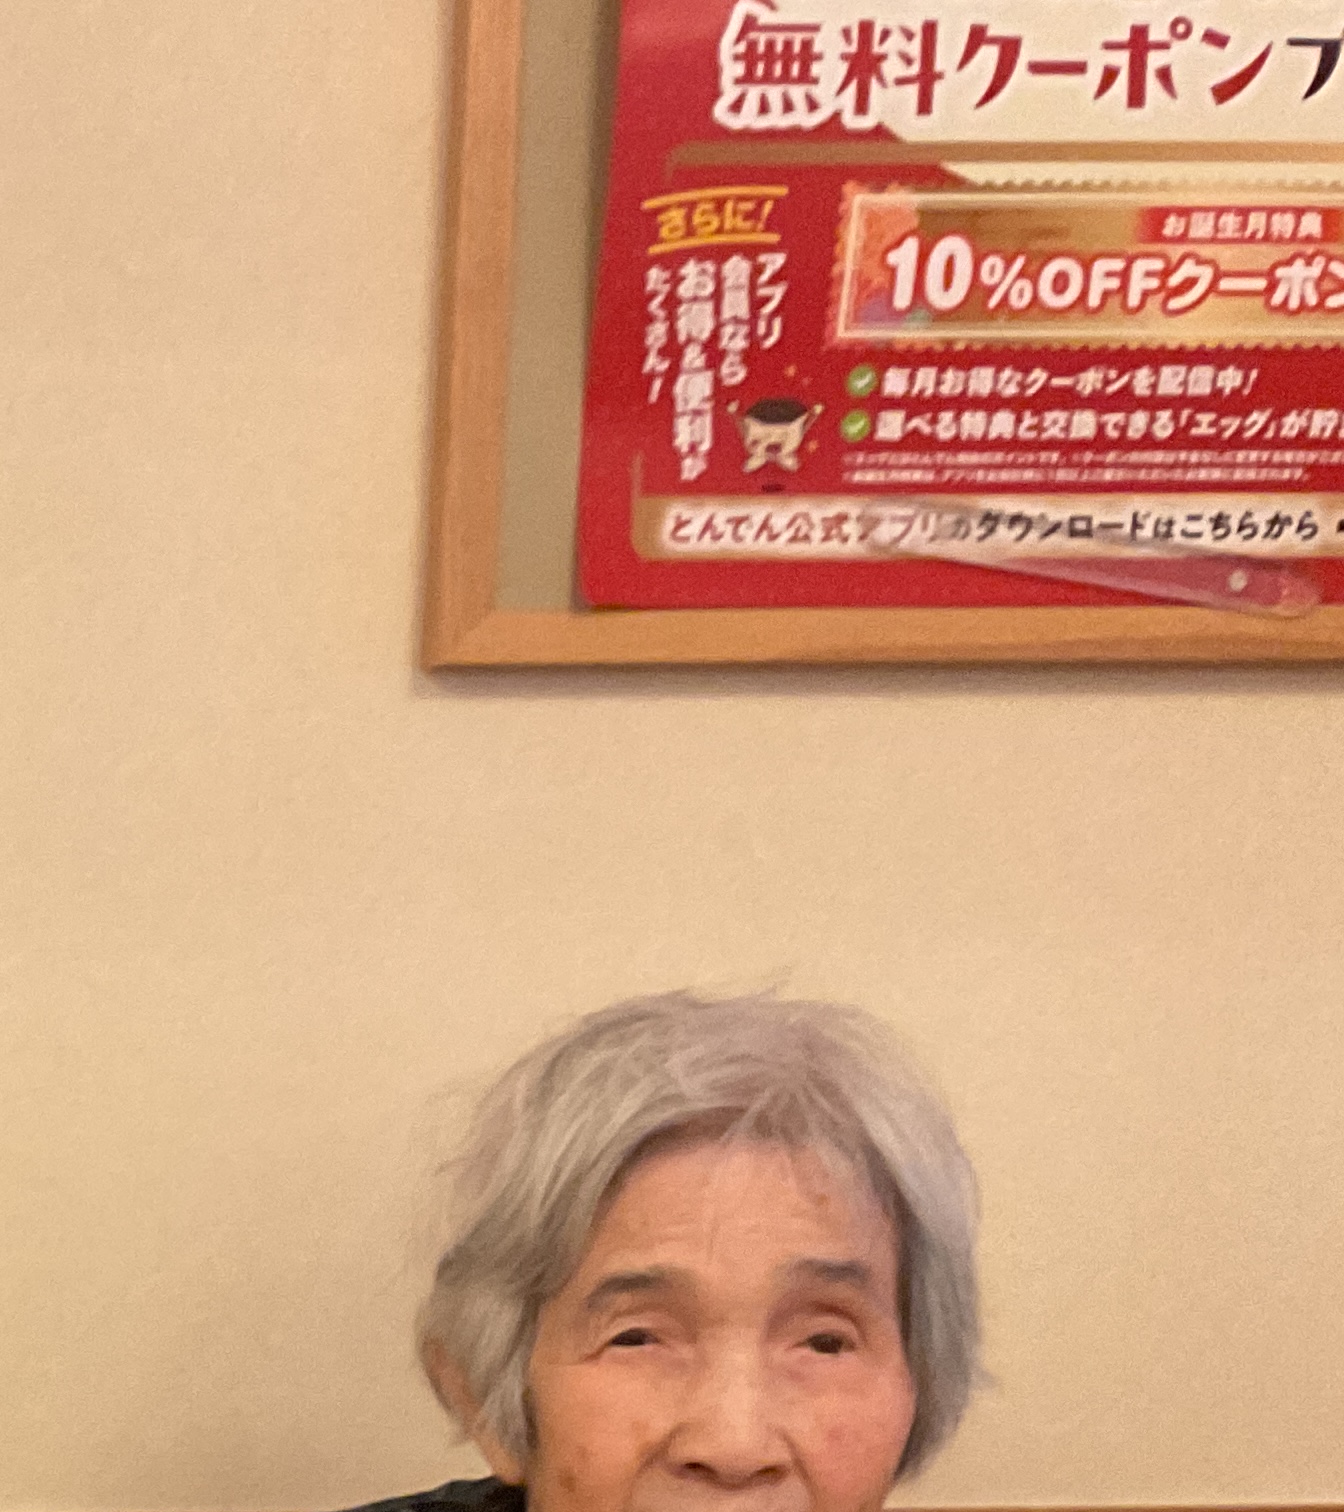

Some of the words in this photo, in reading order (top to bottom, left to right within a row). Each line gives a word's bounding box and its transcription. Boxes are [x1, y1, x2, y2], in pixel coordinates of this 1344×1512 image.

[1162, 211, 1323, 240] お誕生月特典
[756, 252, 788, 349] アプリ
[873, 407, 1344, 442] 選べる特典と交換できる「エッグ」が貯
